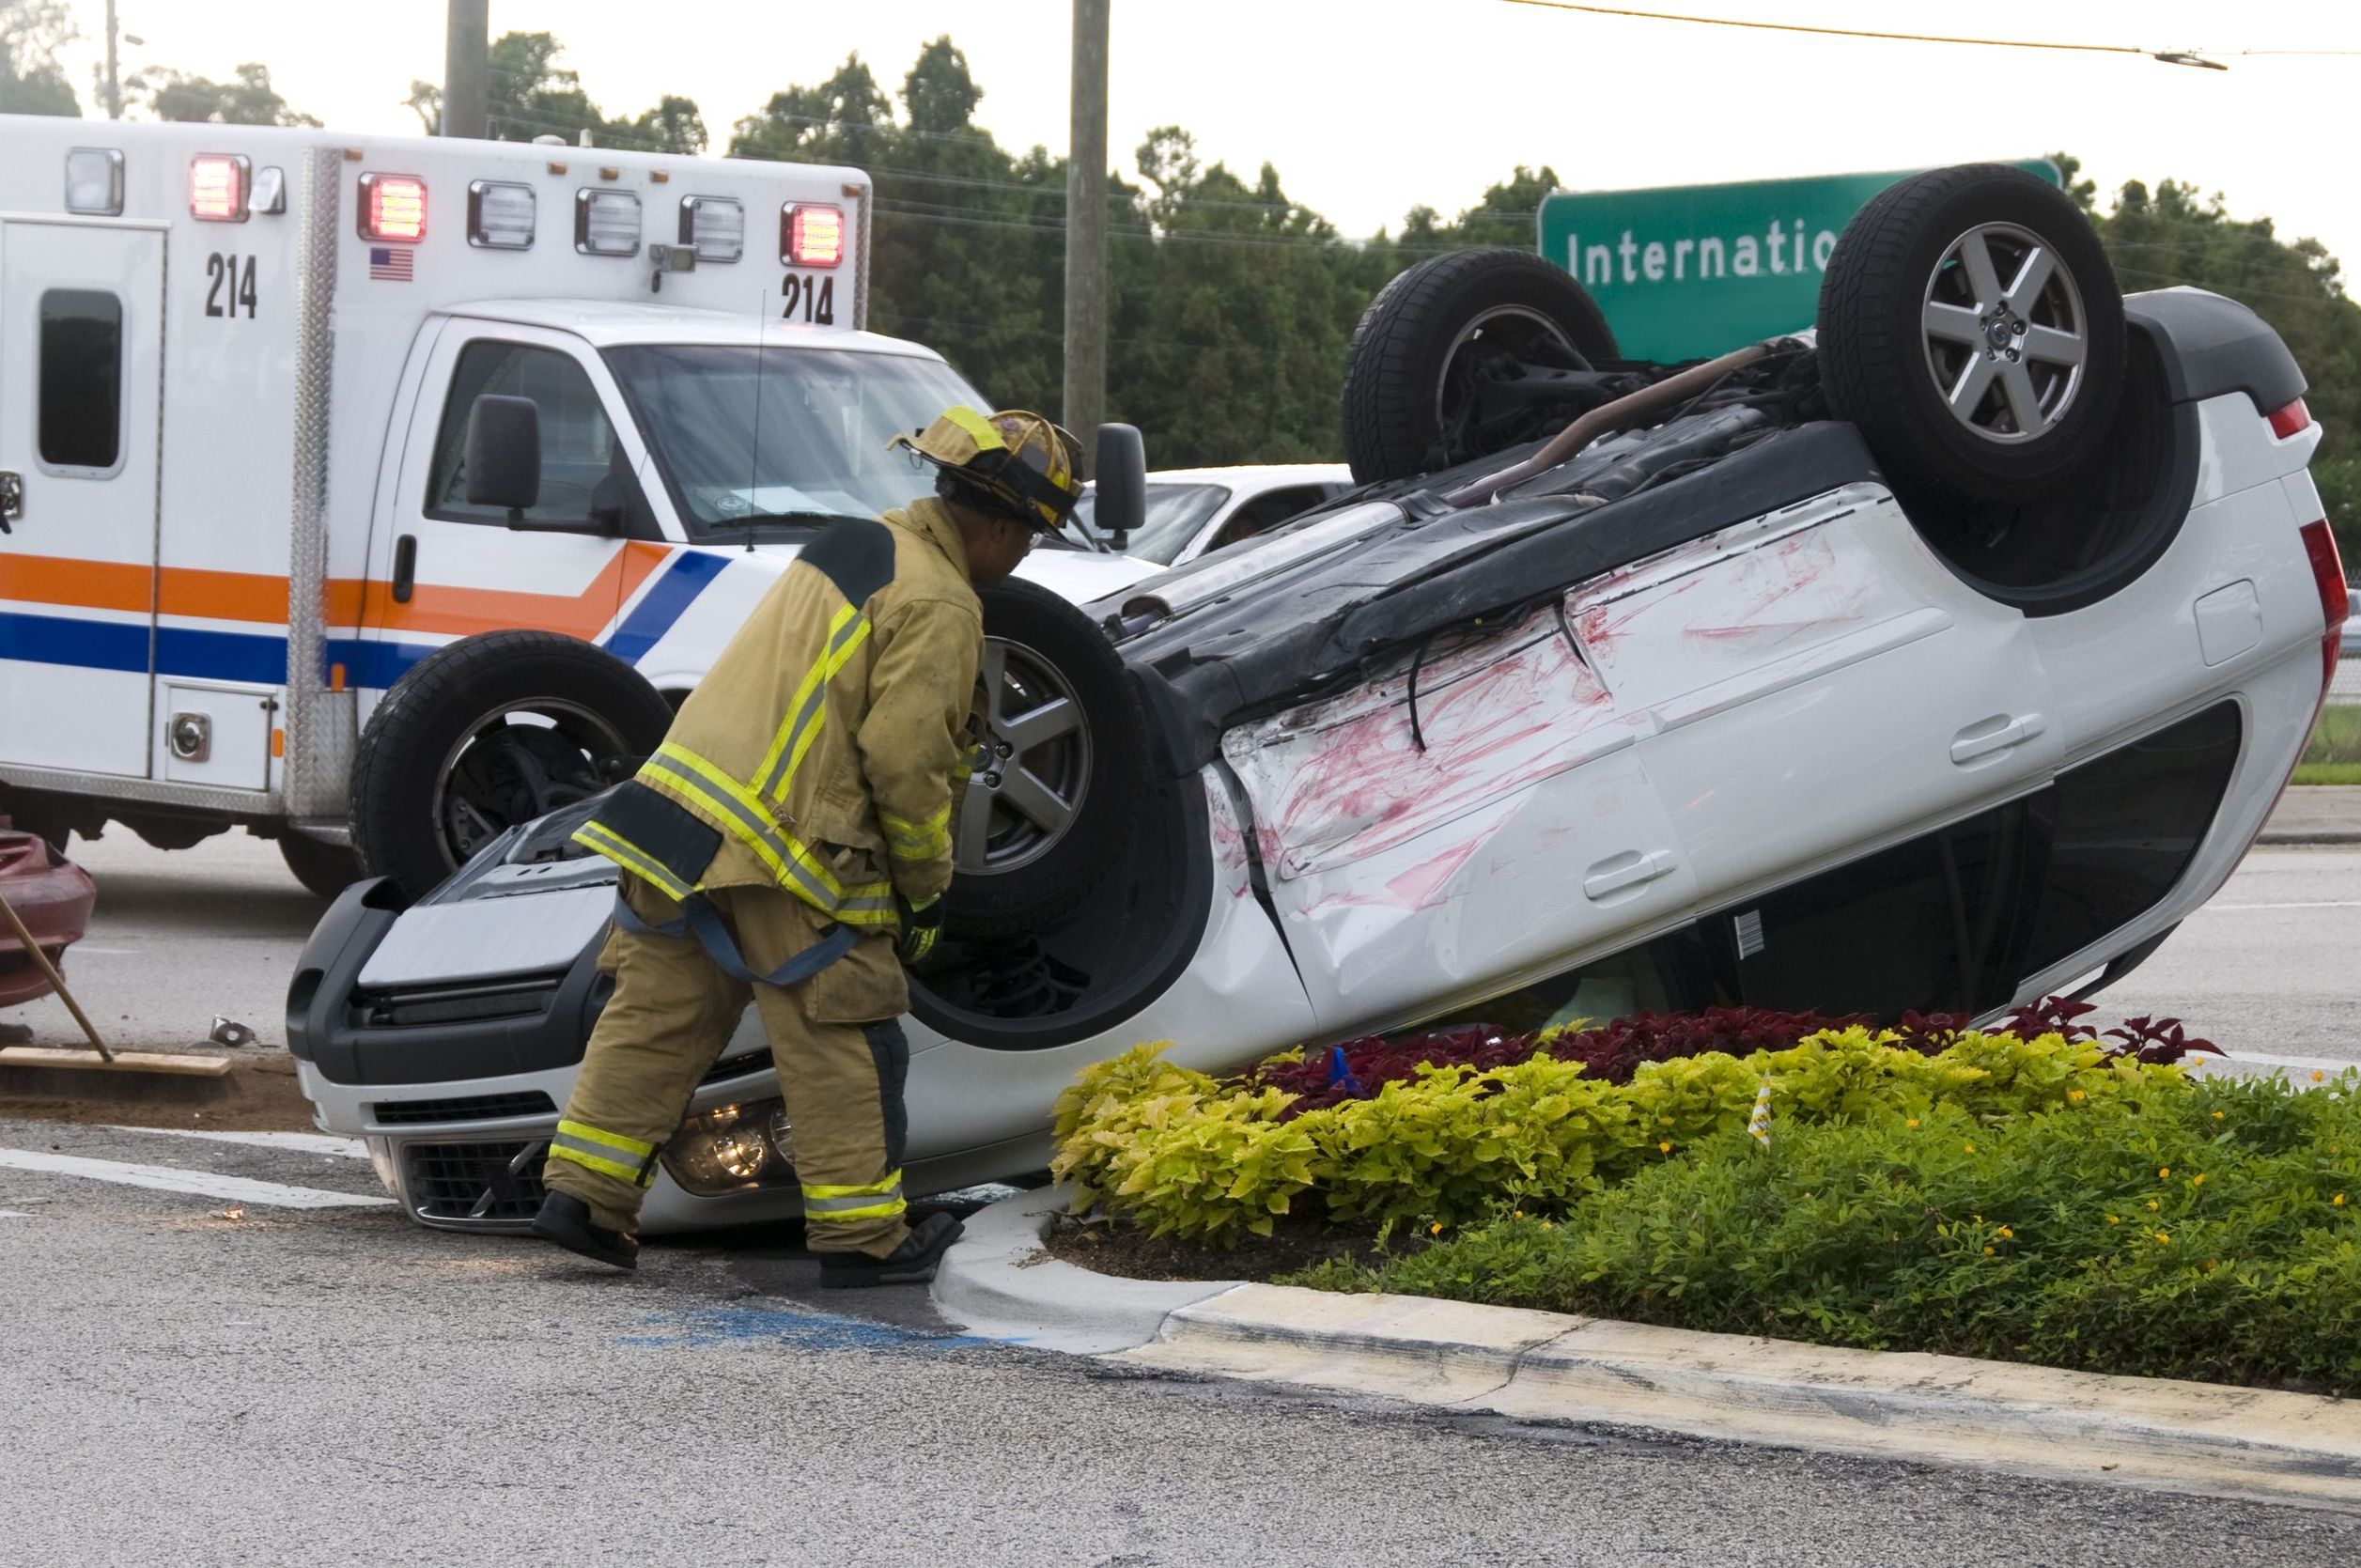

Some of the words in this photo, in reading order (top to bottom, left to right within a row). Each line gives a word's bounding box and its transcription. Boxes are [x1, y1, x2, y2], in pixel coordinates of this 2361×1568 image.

[1568, 218, 1838, 285] Internatio
[206, 252, 256, 318] 214
[782, 272, 833, 325] 214
